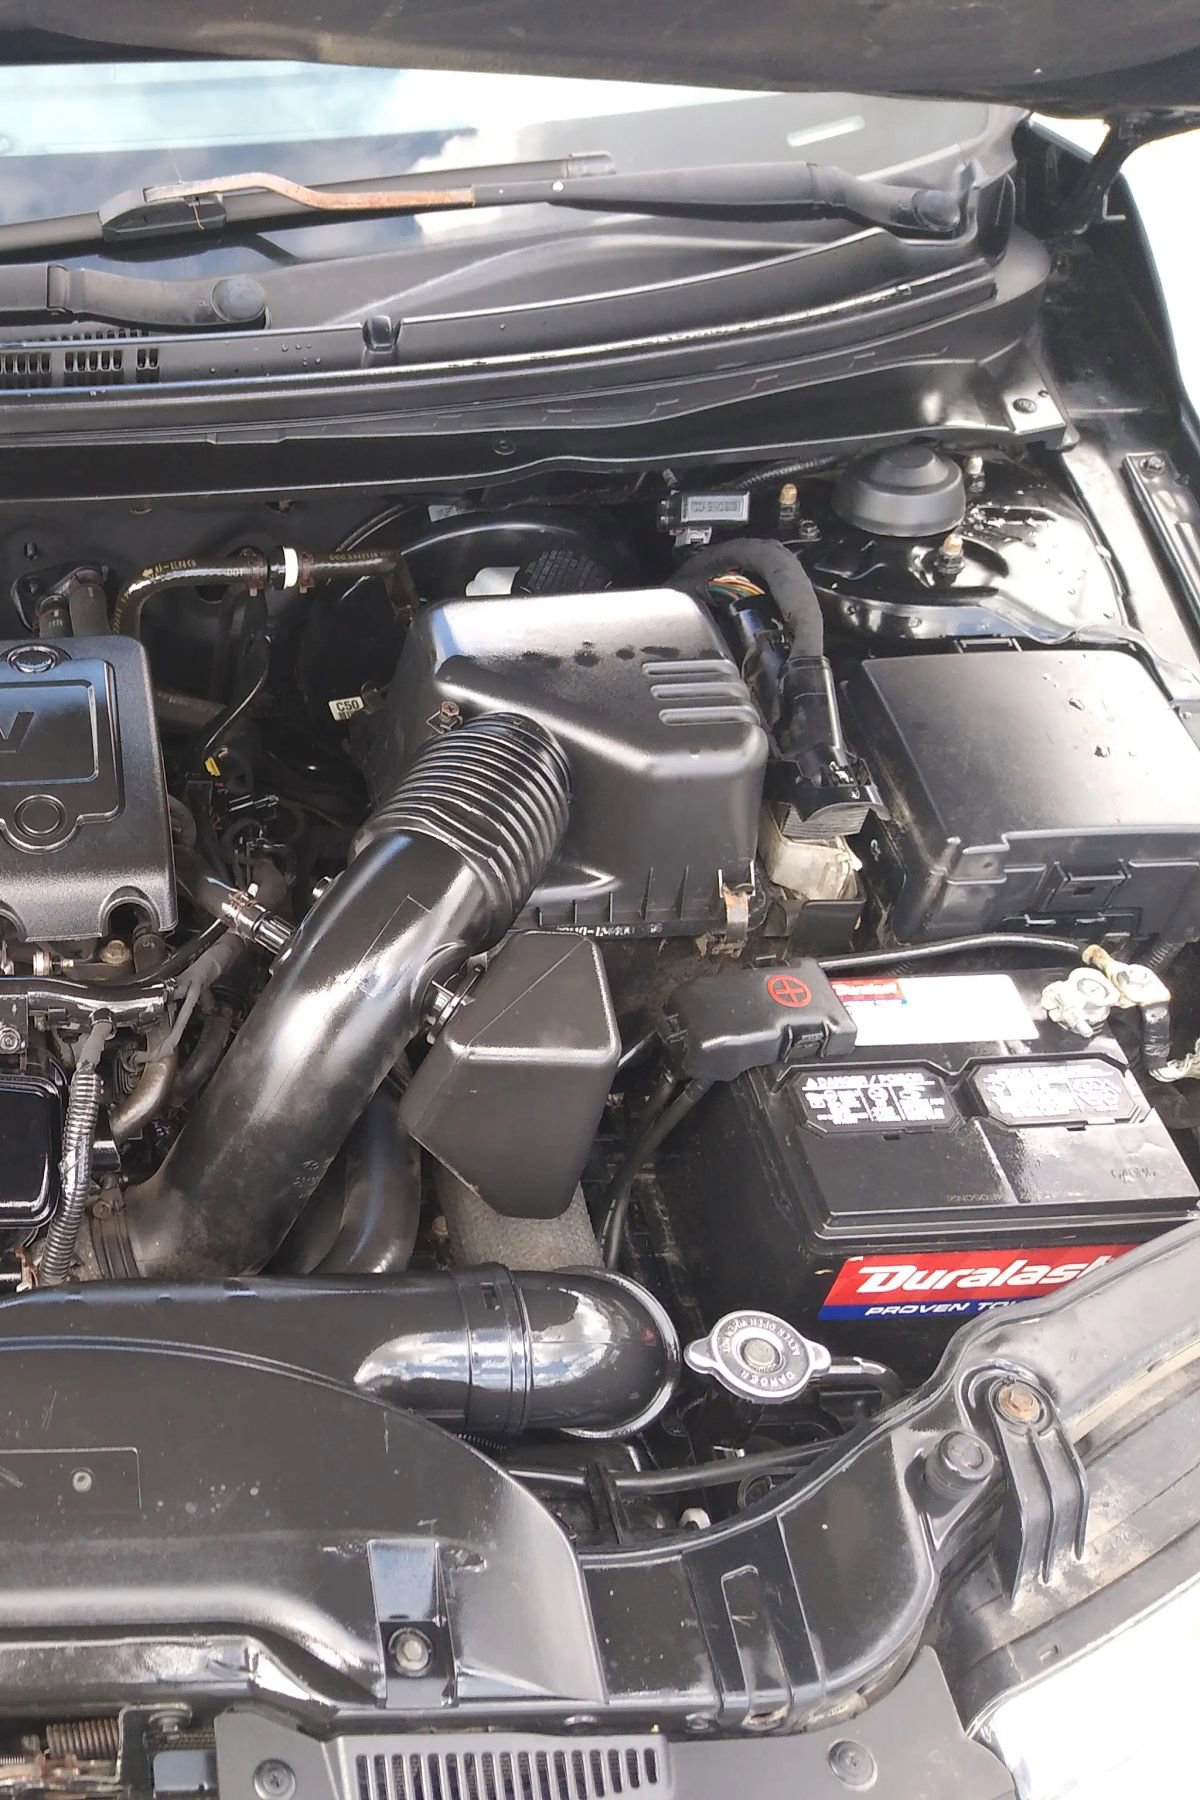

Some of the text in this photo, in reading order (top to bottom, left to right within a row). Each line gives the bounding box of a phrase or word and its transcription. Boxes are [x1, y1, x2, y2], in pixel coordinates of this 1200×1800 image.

[336, 700, 360, 712] C50
[865, 1302, 971, 1316] PROVEN
[740, 1370, 795, 1387] DANGER
